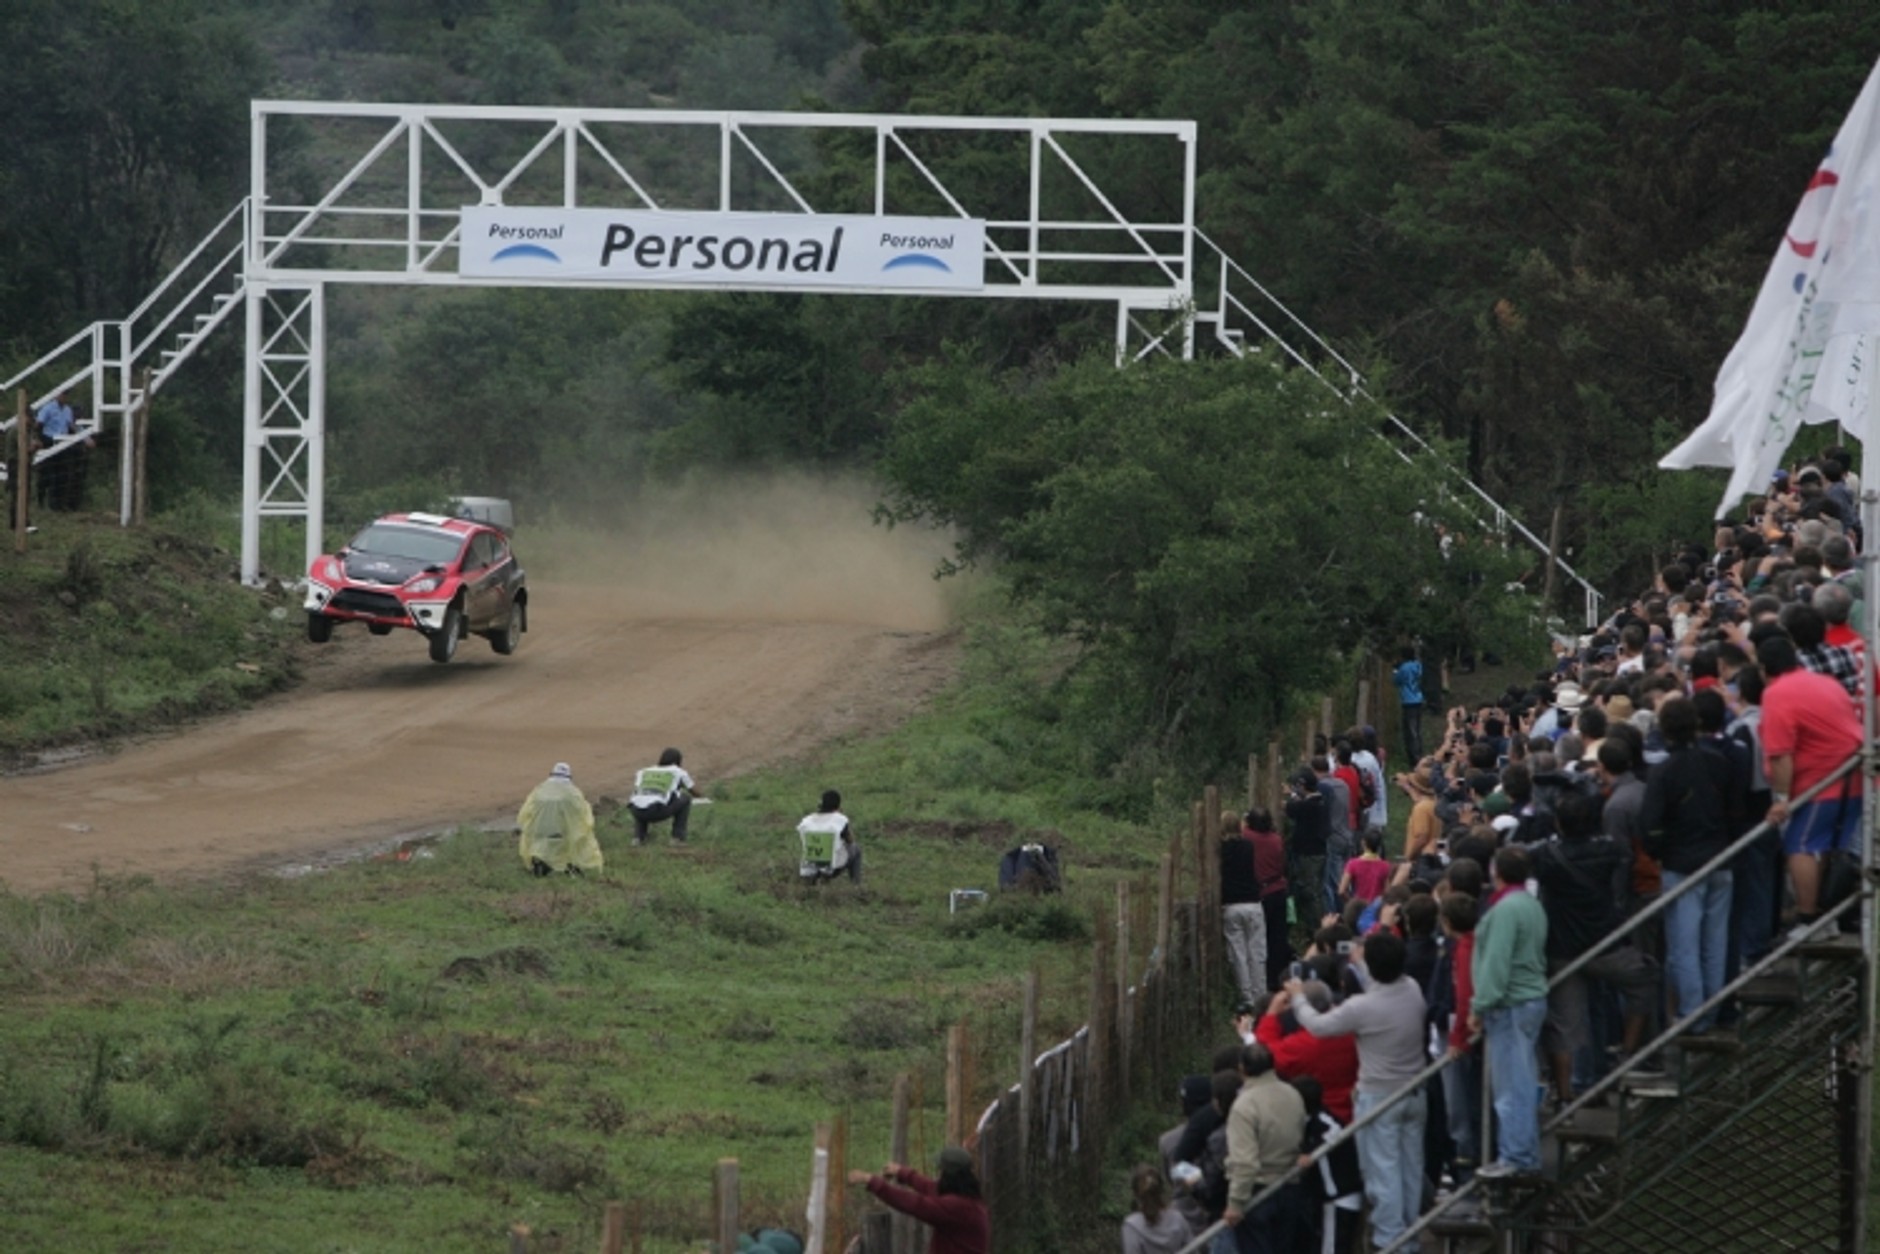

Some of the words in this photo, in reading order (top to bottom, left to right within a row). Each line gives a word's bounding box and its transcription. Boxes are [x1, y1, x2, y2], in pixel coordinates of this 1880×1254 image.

[488, 223, 564, 240] Personal
[599, 223, 844, 273] Personal
[879, 233, 954, 250] Personal
